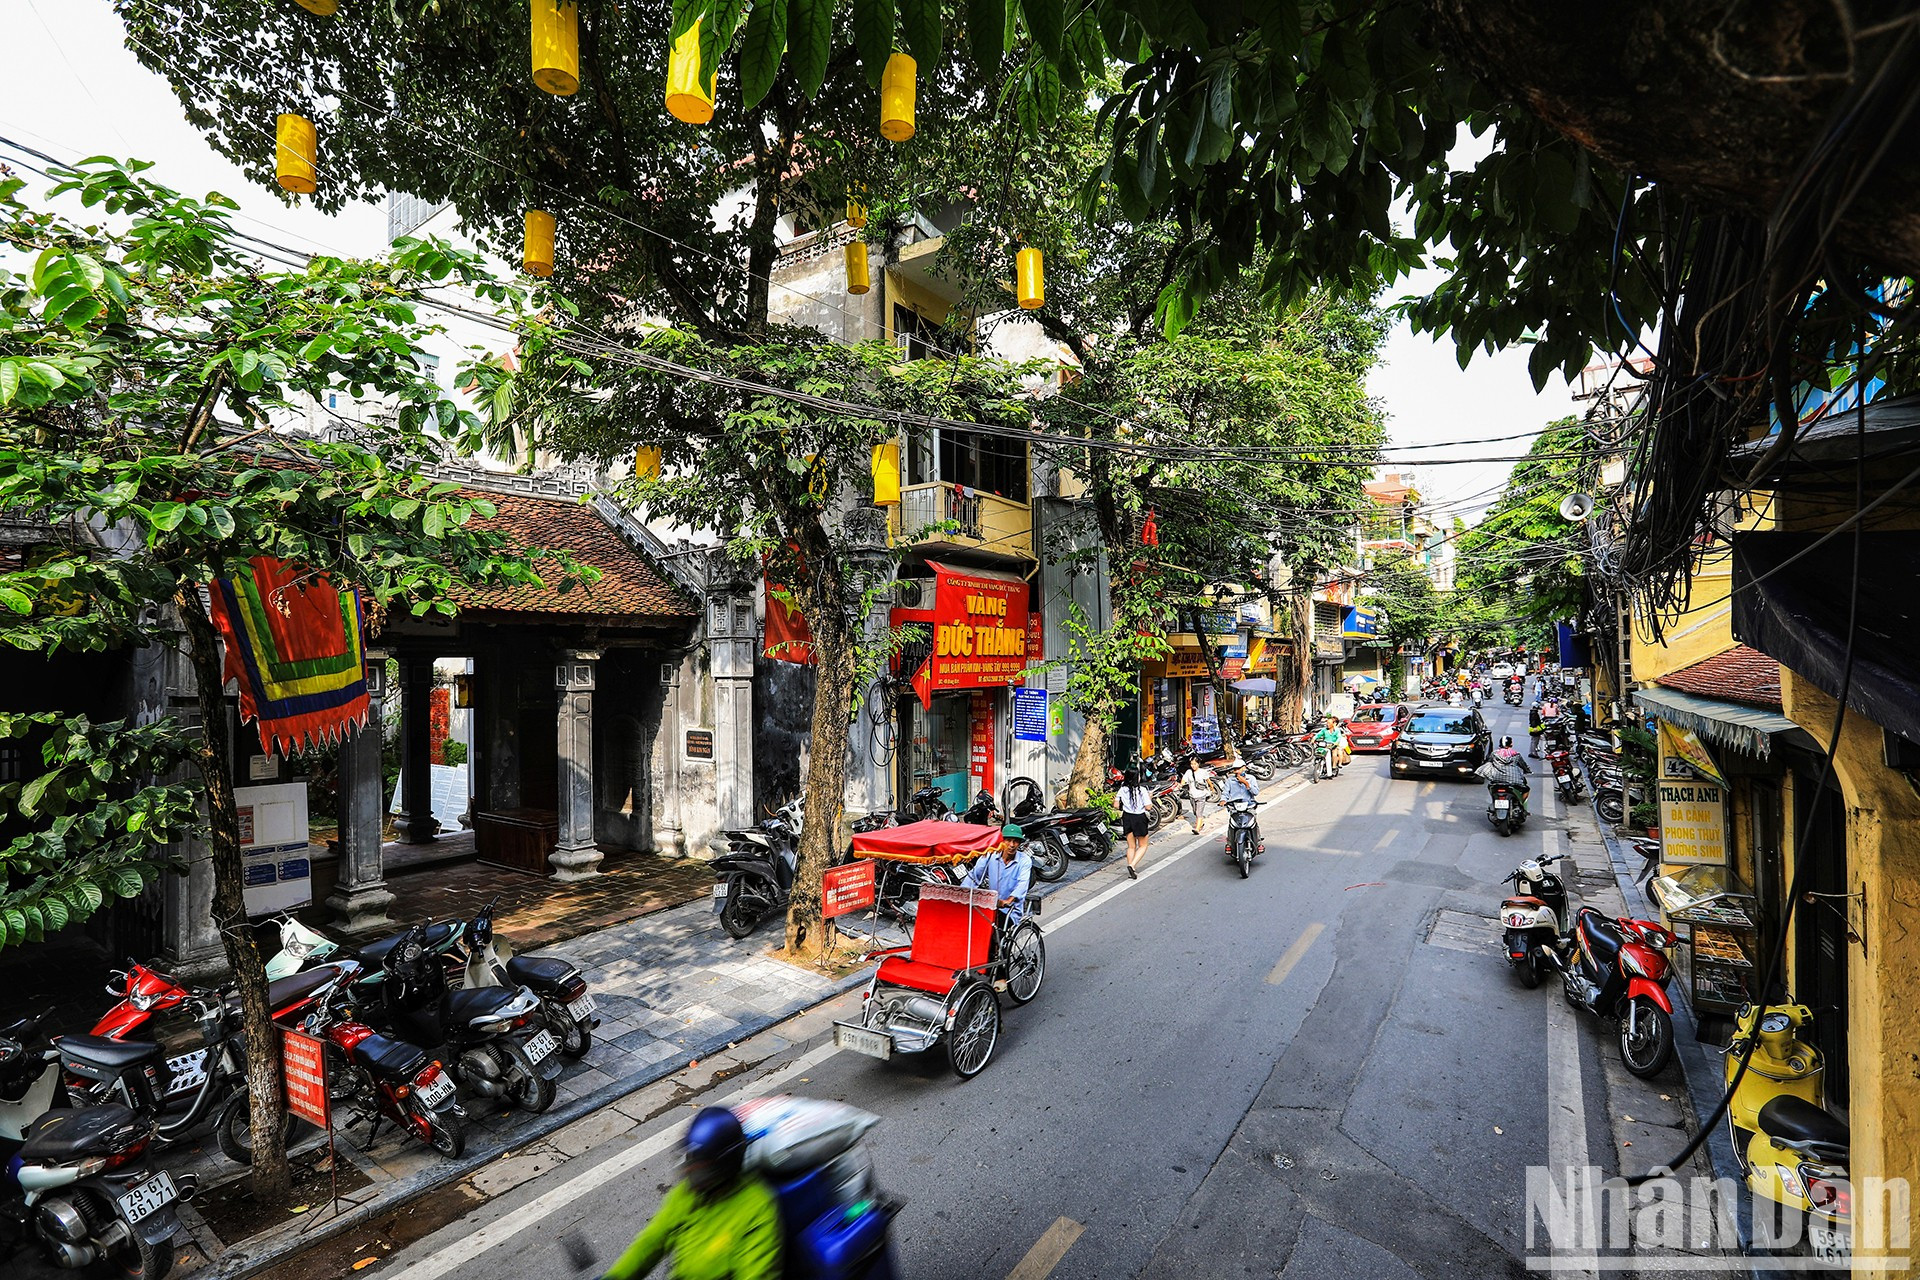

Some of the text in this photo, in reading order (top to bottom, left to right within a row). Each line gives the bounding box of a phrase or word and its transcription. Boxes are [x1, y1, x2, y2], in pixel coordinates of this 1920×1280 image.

[966, 592, 1006, 616] VÀNG
[937, 619, 973, 656] ĐỨC
[975, 621, 1024, 656] THẮNG
[939, 663, 950, 674] MUA
[1667, 760, 1692, 774] 47
[1660, 787, 1719, 805] THẠCH ANH
[1686, 805, 1711, 822] CẢNH
[1665, 827, 1695, 840] PHONG
[1667, 842, 1723, 858] DƯỠNG SINH
[575, 1002, 594, 1018] 5591
[527, 1034, 548, 1054] 29-G1
[531, 1040, 555, 1063] 419.45
[126, 1177, 163, 1208] 29-G1
[129, 1186, 173, 1222] 361.71
[1816, 1246, 1851, 1267] 461.
